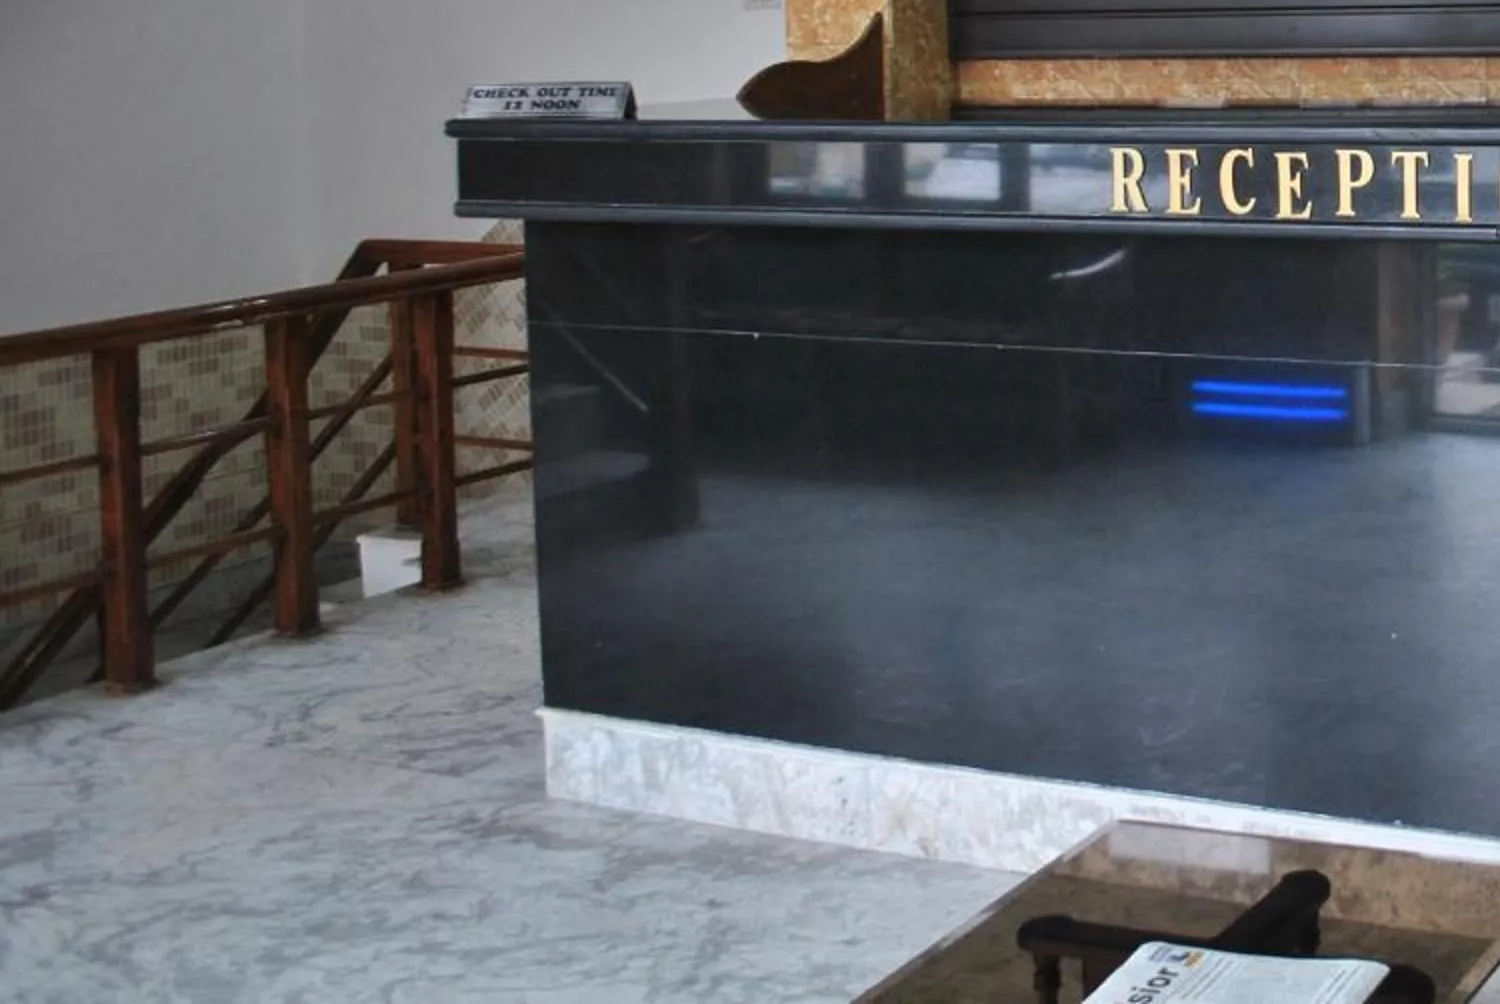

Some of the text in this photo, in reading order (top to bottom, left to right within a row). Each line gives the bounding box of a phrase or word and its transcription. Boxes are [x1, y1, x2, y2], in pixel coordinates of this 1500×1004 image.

[473, 86, 617, 99] CHECK OUT TIME
[504, 99, 582, 111] 12 NOON
